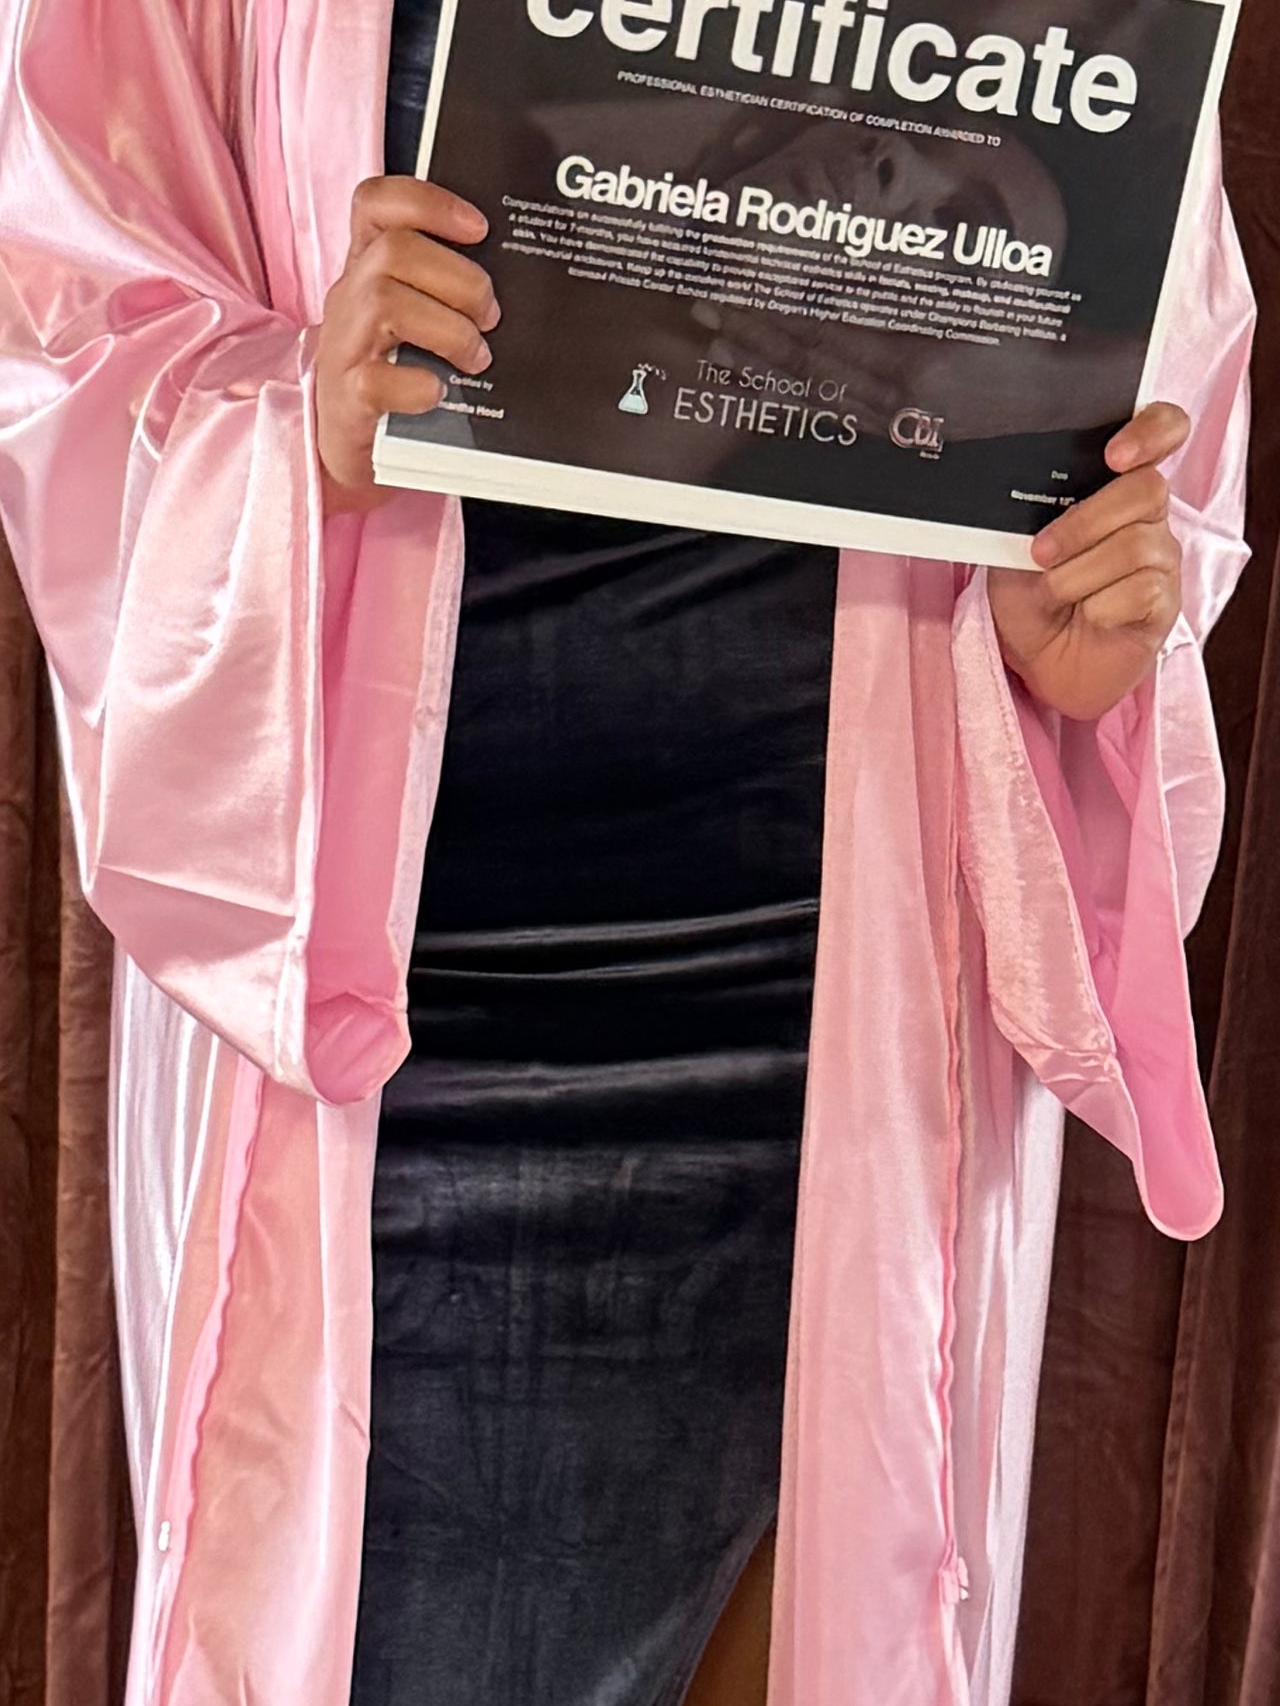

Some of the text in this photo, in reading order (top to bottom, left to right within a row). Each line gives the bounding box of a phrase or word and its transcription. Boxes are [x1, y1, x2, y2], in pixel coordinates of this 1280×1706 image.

[617, 71, 696, 94] PROFESSIONAL
[850, 111, 862, 123] OF
[866, 115, 932, 134] COMPLETION
[987, 134, 1000, 147] TO
[557, 156, 1052, 277] Gabriela Rodriguez Ulloa
[697, 359, 848, 402] The School Of
[674, 387, 857, 445] ESTHETICS
